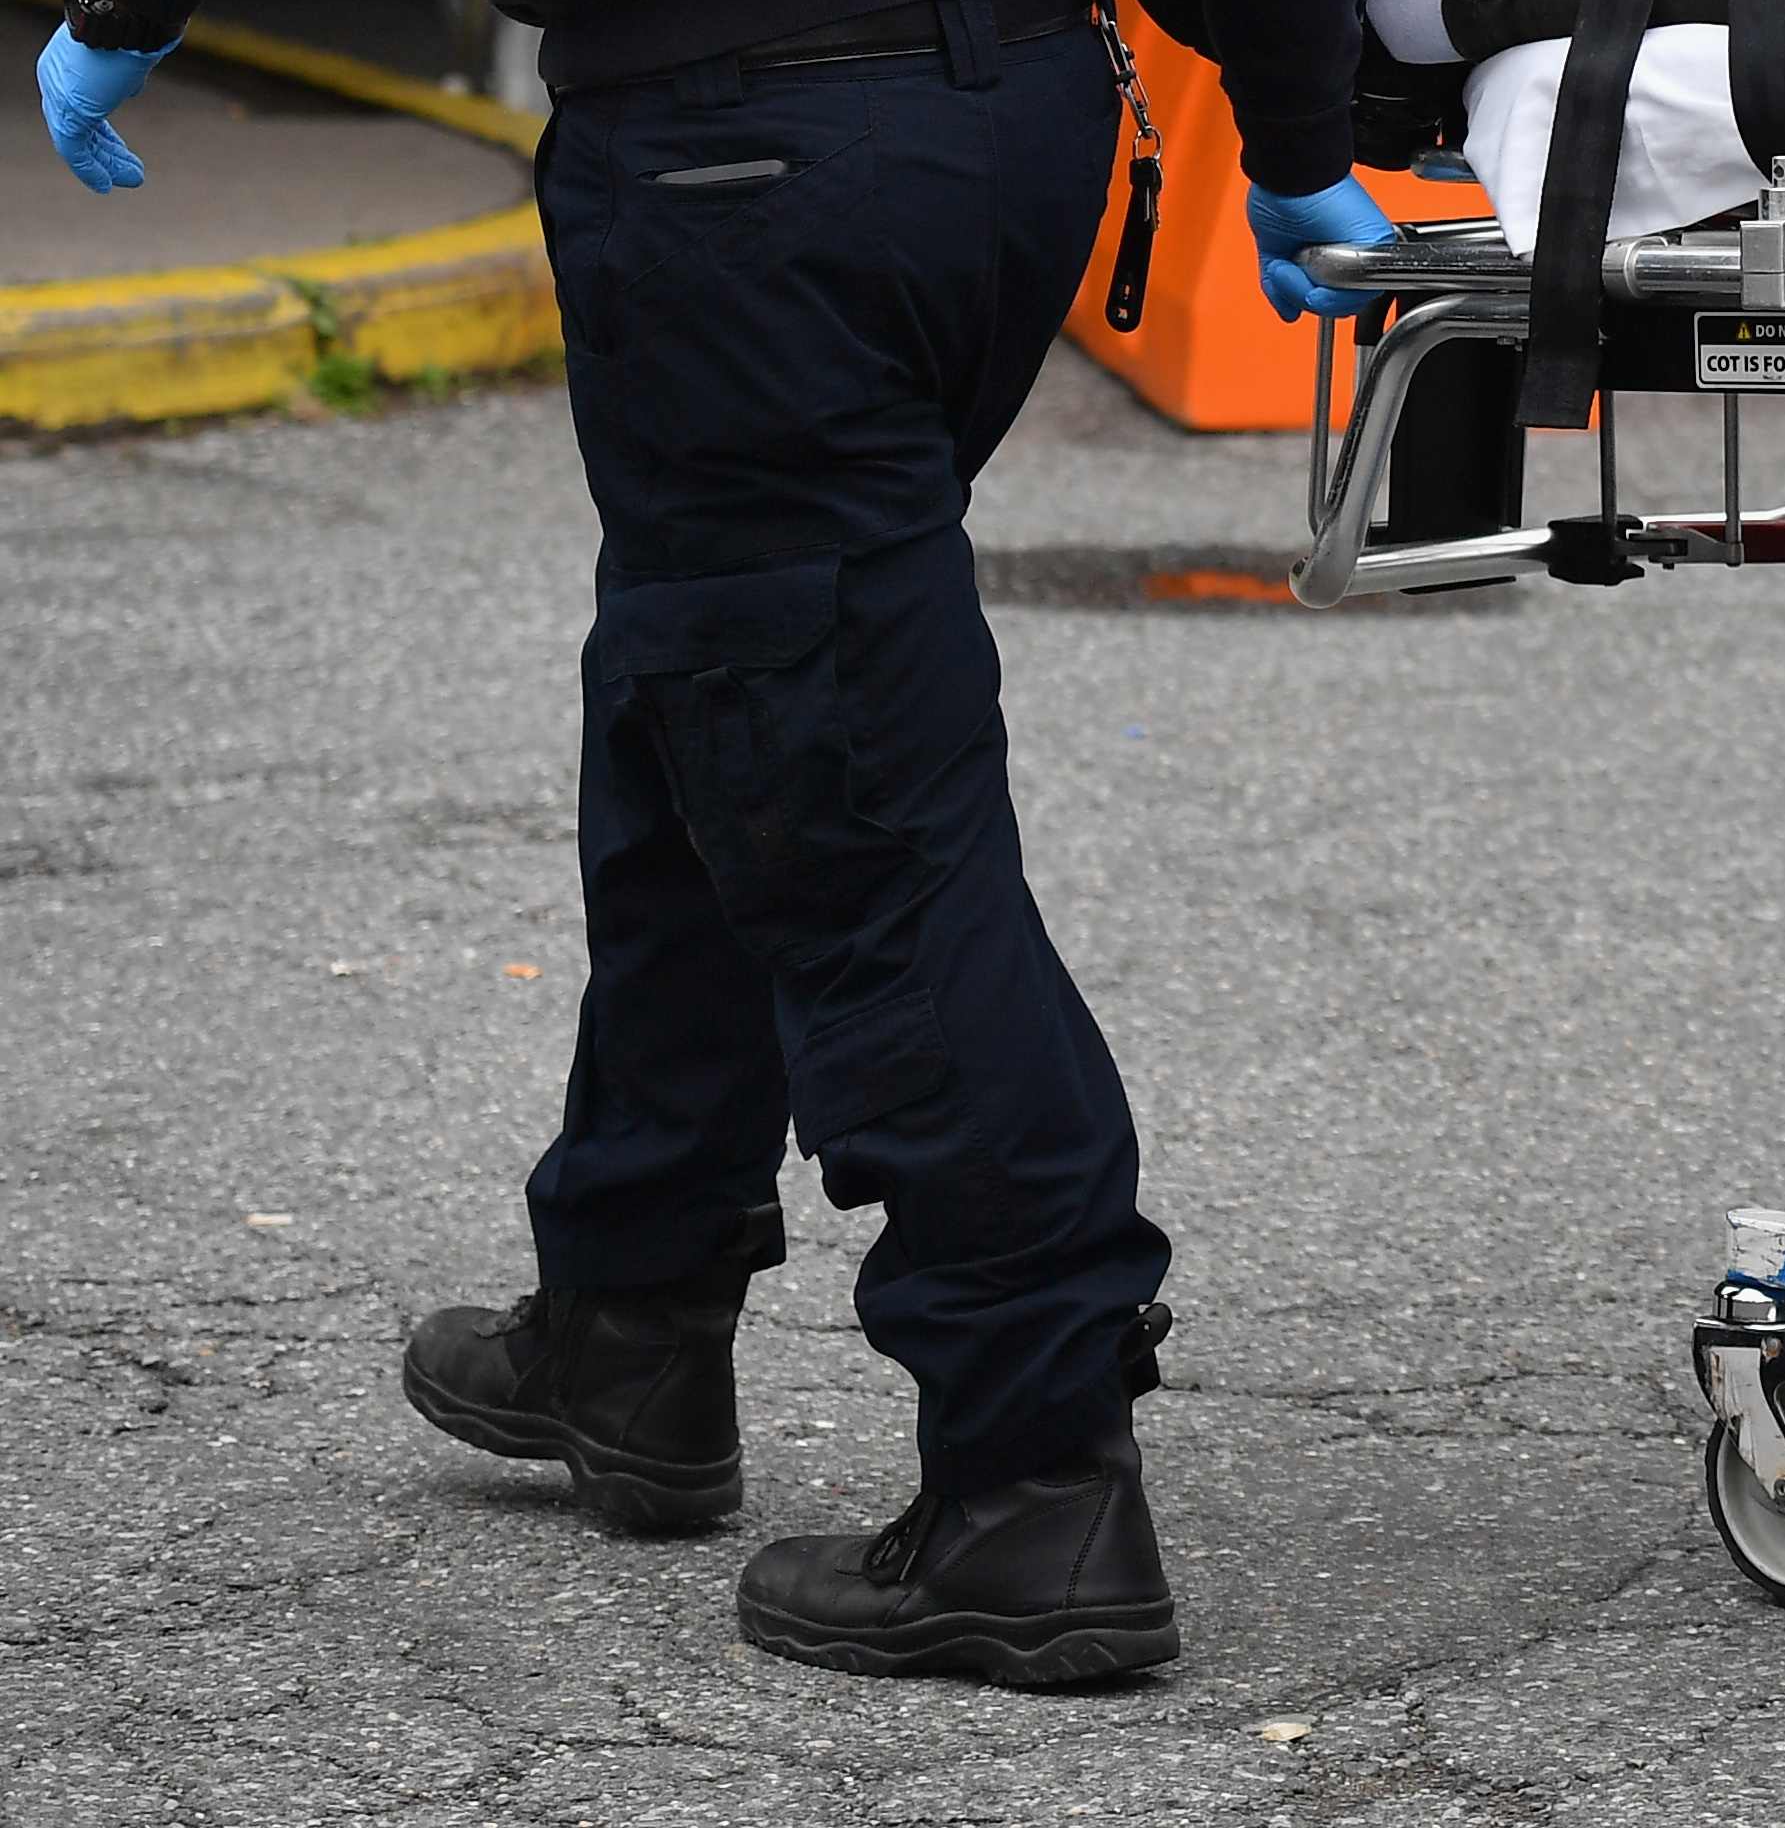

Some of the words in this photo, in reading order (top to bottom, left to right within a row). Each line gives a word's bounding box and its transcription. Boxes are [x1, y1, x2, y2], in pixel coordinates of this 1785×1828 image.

[1755, 324, 1776, 338] DO
[1706, 355, 1740, 373] COT
[1744, 355, 1759, 372] IS
